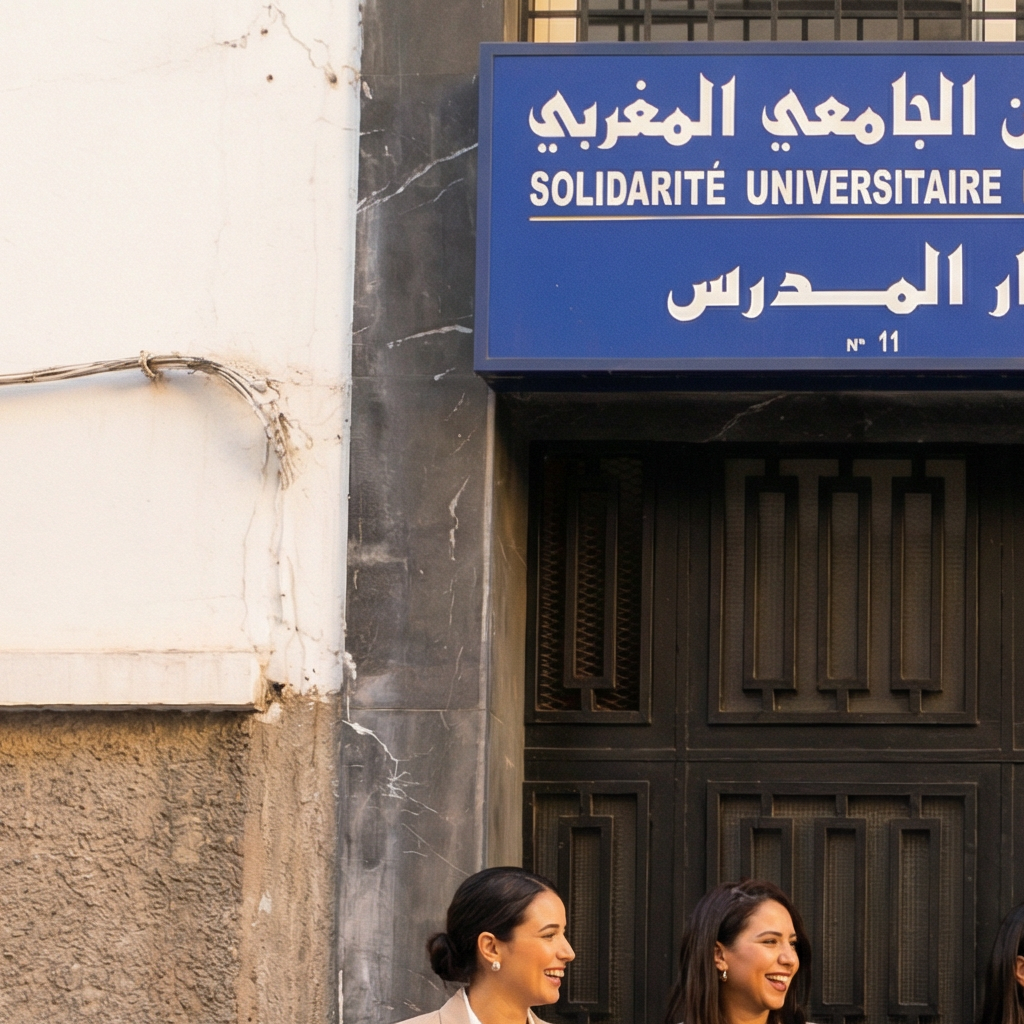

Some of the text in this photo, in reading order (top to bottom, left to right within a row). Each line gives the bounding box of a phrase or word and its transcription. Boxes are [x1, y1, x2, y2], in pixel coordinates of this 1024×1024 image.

[528, 72, 736, 154] المغربي
[761, 71, 976, 152] الجامعي
[529, 160, 726, 207] SOLIDARITÉ
[746, 168, 1002, 206] UNIVERSITAIRE
[667, 241, 964, 322] المدرس
[878, 330, 899, 353] 11
